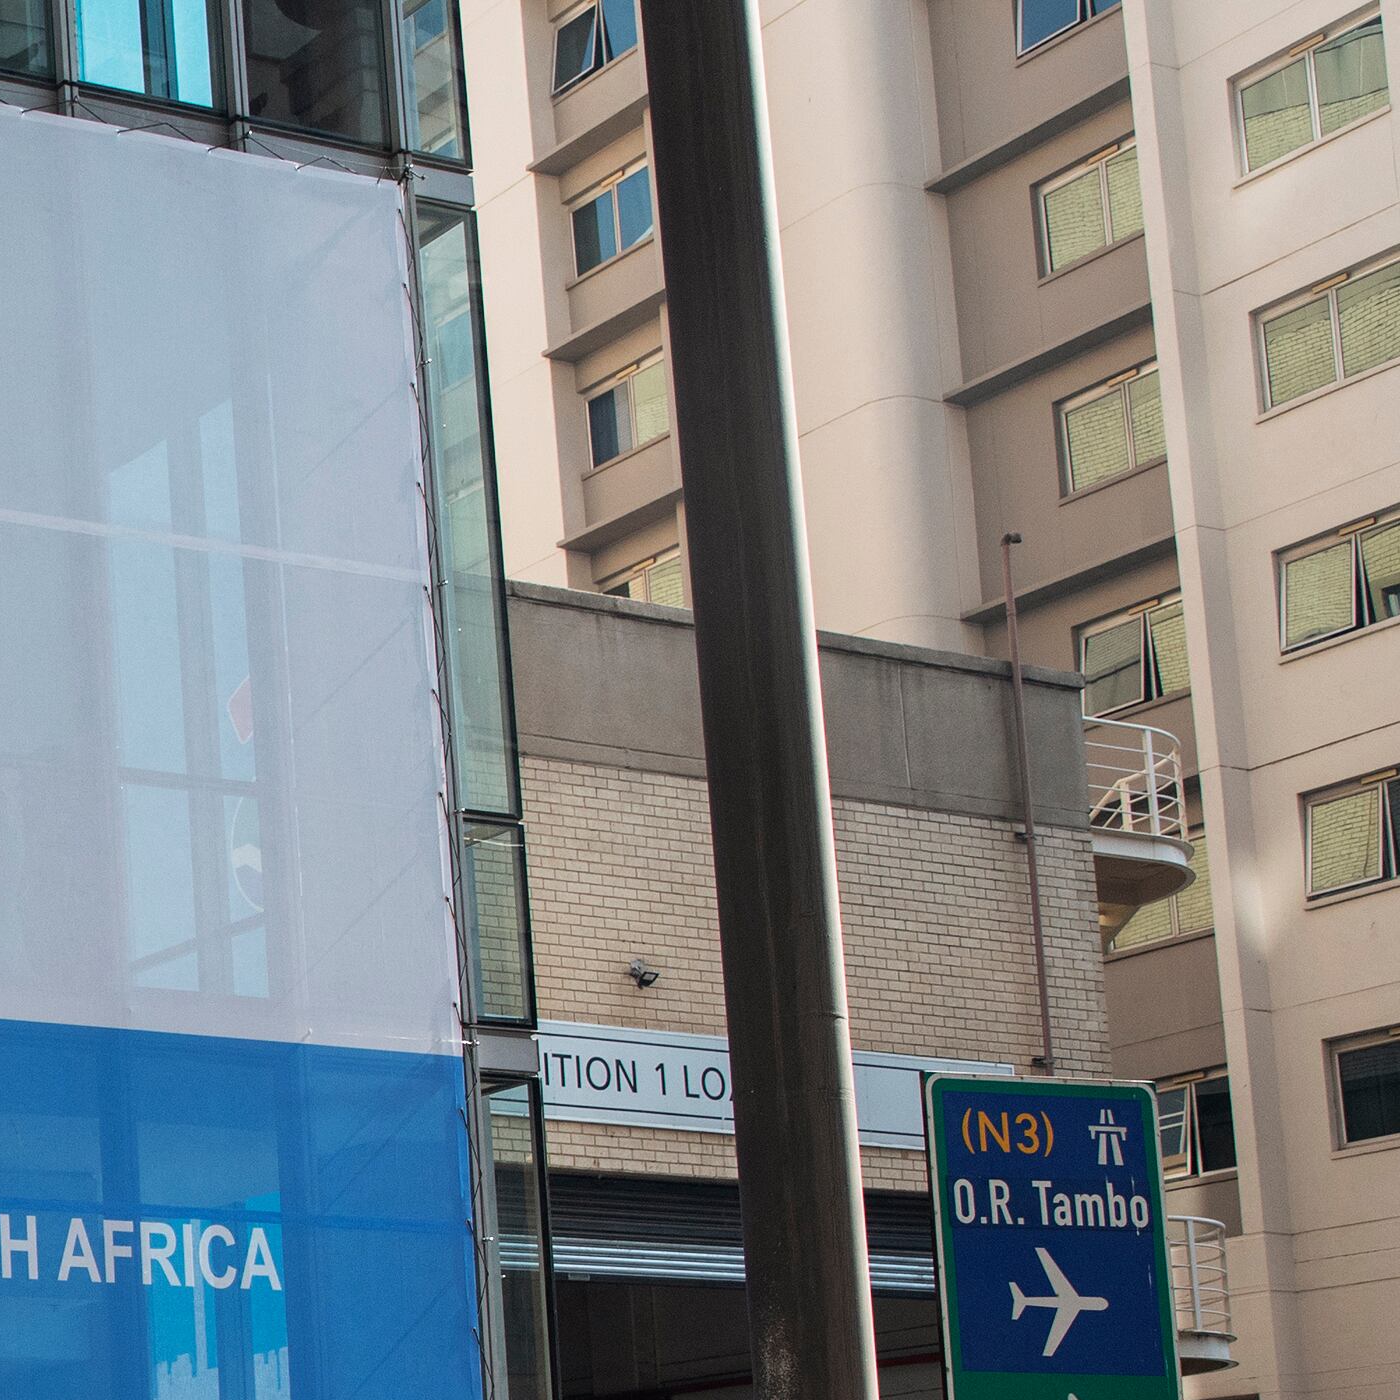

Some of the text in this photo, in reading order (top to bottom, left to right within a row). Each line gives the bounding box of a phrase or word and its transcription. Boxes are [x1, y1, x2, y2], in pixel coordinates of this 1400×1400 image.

[655, 1062, 667, 1096] 1
[683, 1064, 734, 1102] LO
[961, 1107, 1054, 1158] (N3)
[953, 1178, 1149, 1229] O.R. Tambo
[57, 1216, 283, 1291] AFRICA
